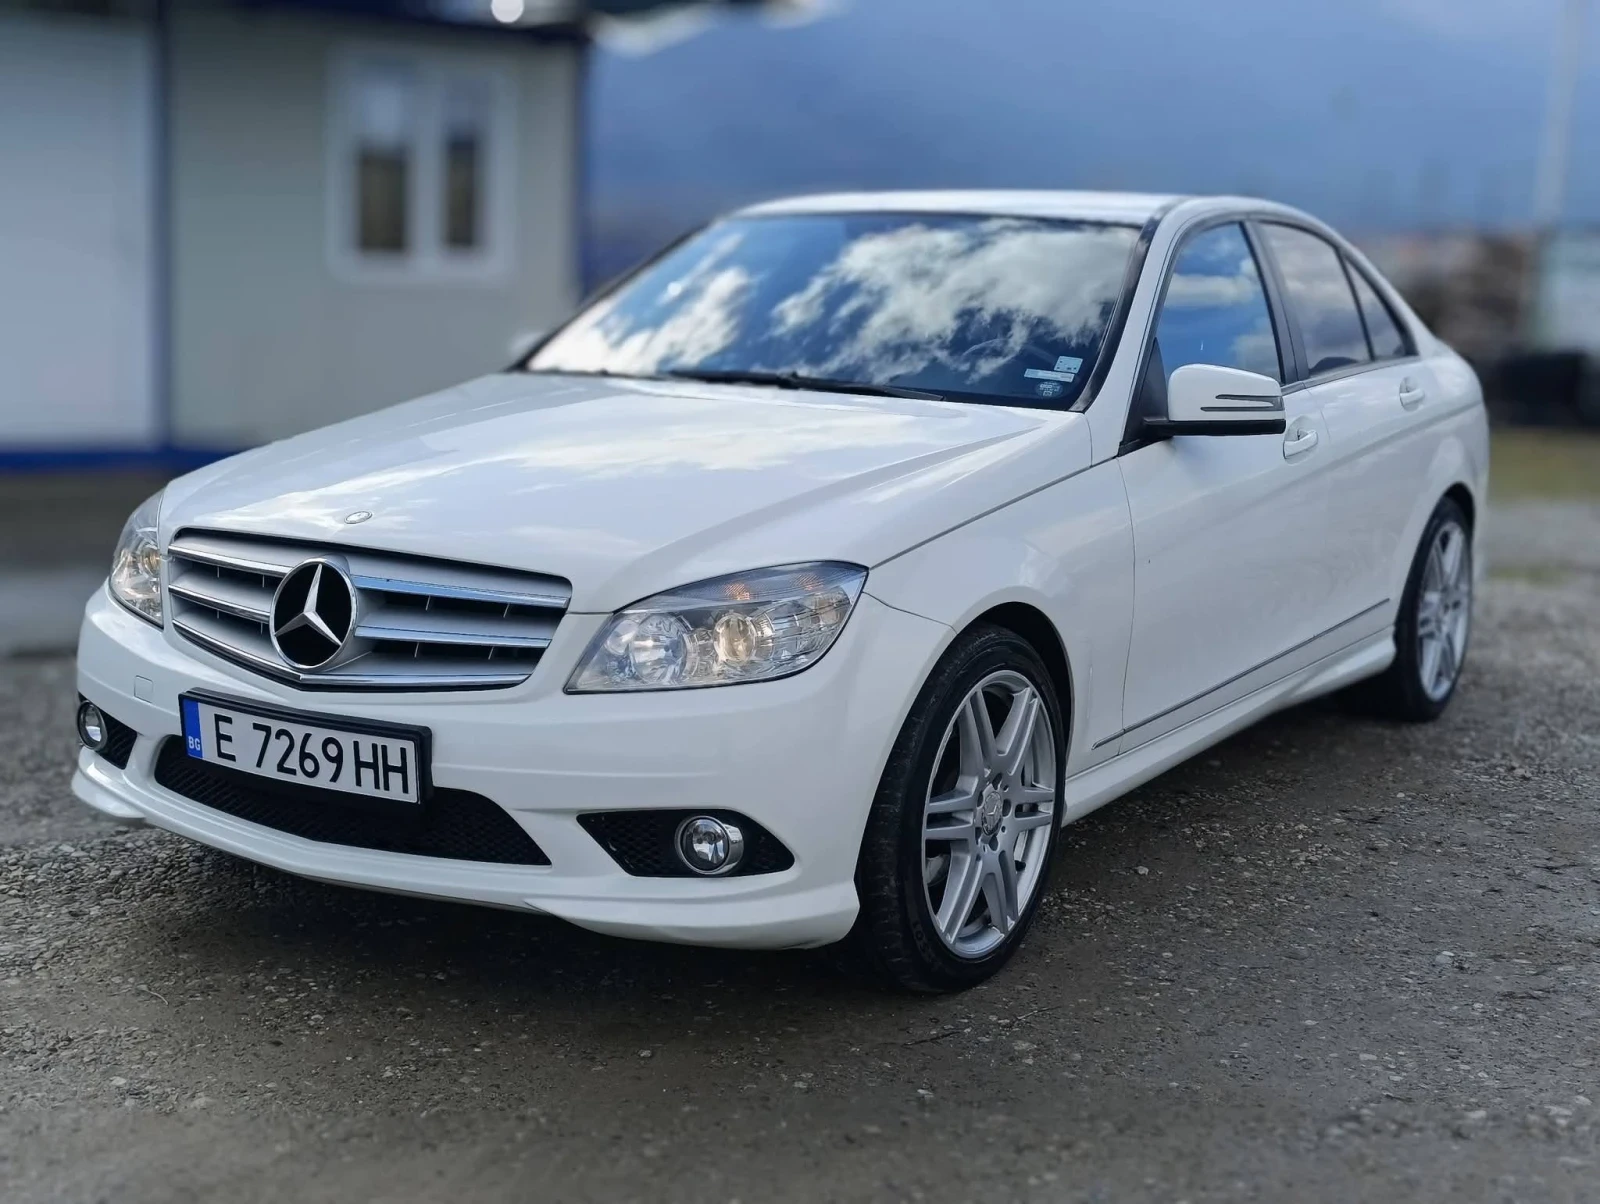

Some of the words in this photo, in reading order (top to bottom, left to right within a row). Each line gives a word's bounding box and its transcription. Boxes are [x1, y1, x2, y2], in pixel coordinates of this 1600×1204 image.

[188, 737, 201, 750] BG
[214, 713, 237, 763] E
[252, 722, 344, 783] 7269
[353, 740, 409, 794] HH
